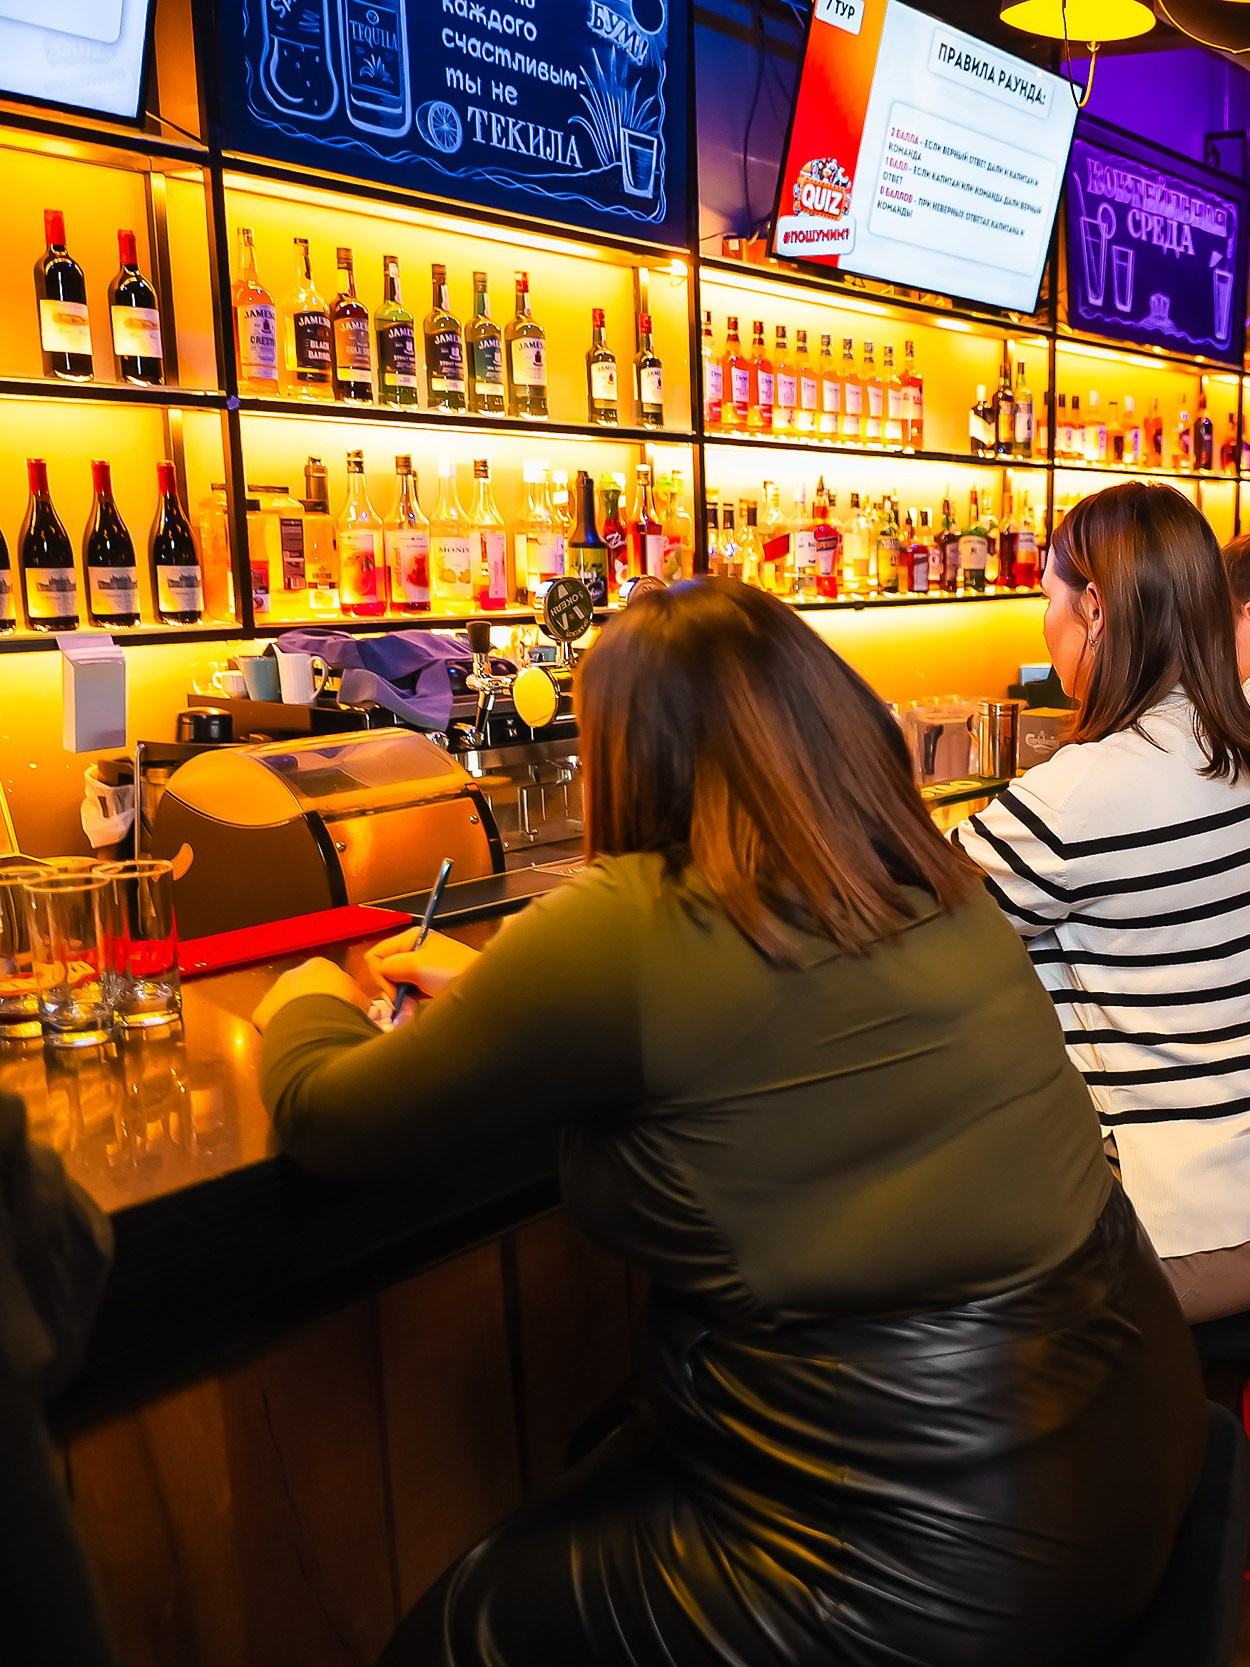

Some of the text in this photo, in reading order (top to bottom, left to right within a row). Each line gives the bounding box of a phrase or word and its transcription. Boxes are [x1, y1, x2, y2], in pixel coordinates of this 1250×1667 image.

[835, 0, 856, 20] ТУР
[445, 66, 518, 106] ты не
[938, 42, 1047, 105] ПРАВИЛА РАУНДА:
[467, 105, 583, 169] ТЕКИЛА
[888, 142, 922, 161] КОМАНДА
[896, 129, 919, 145] БАЛЛА
[924, 139, 942, 152] ЕСЛИ
[942, 146, 968, 162] ВЕРНЫЙ
[969, 155, 986, 169] ОТВЕТ
[987, 162, 1004, 174] ДАЛИ
[882, 171, 903, 185] ОТВЕТ
[889, 157, 908, 171] БАЛЛ
[913, 165, 931, 178] ЕСЛИ
[931, 172, 961, 188] КАПИТАН
[801, 183, 843, 216] QUIZ
[877, 199, 913, 218] КОМАНДЫ
[885, 187, 913, 203] БАЛЛОВ
[918, 197, 931, 209] ПРИ
[1127, 208, 1196, 259] СРЕДА
[244, 309, 276, 321] JAMES
